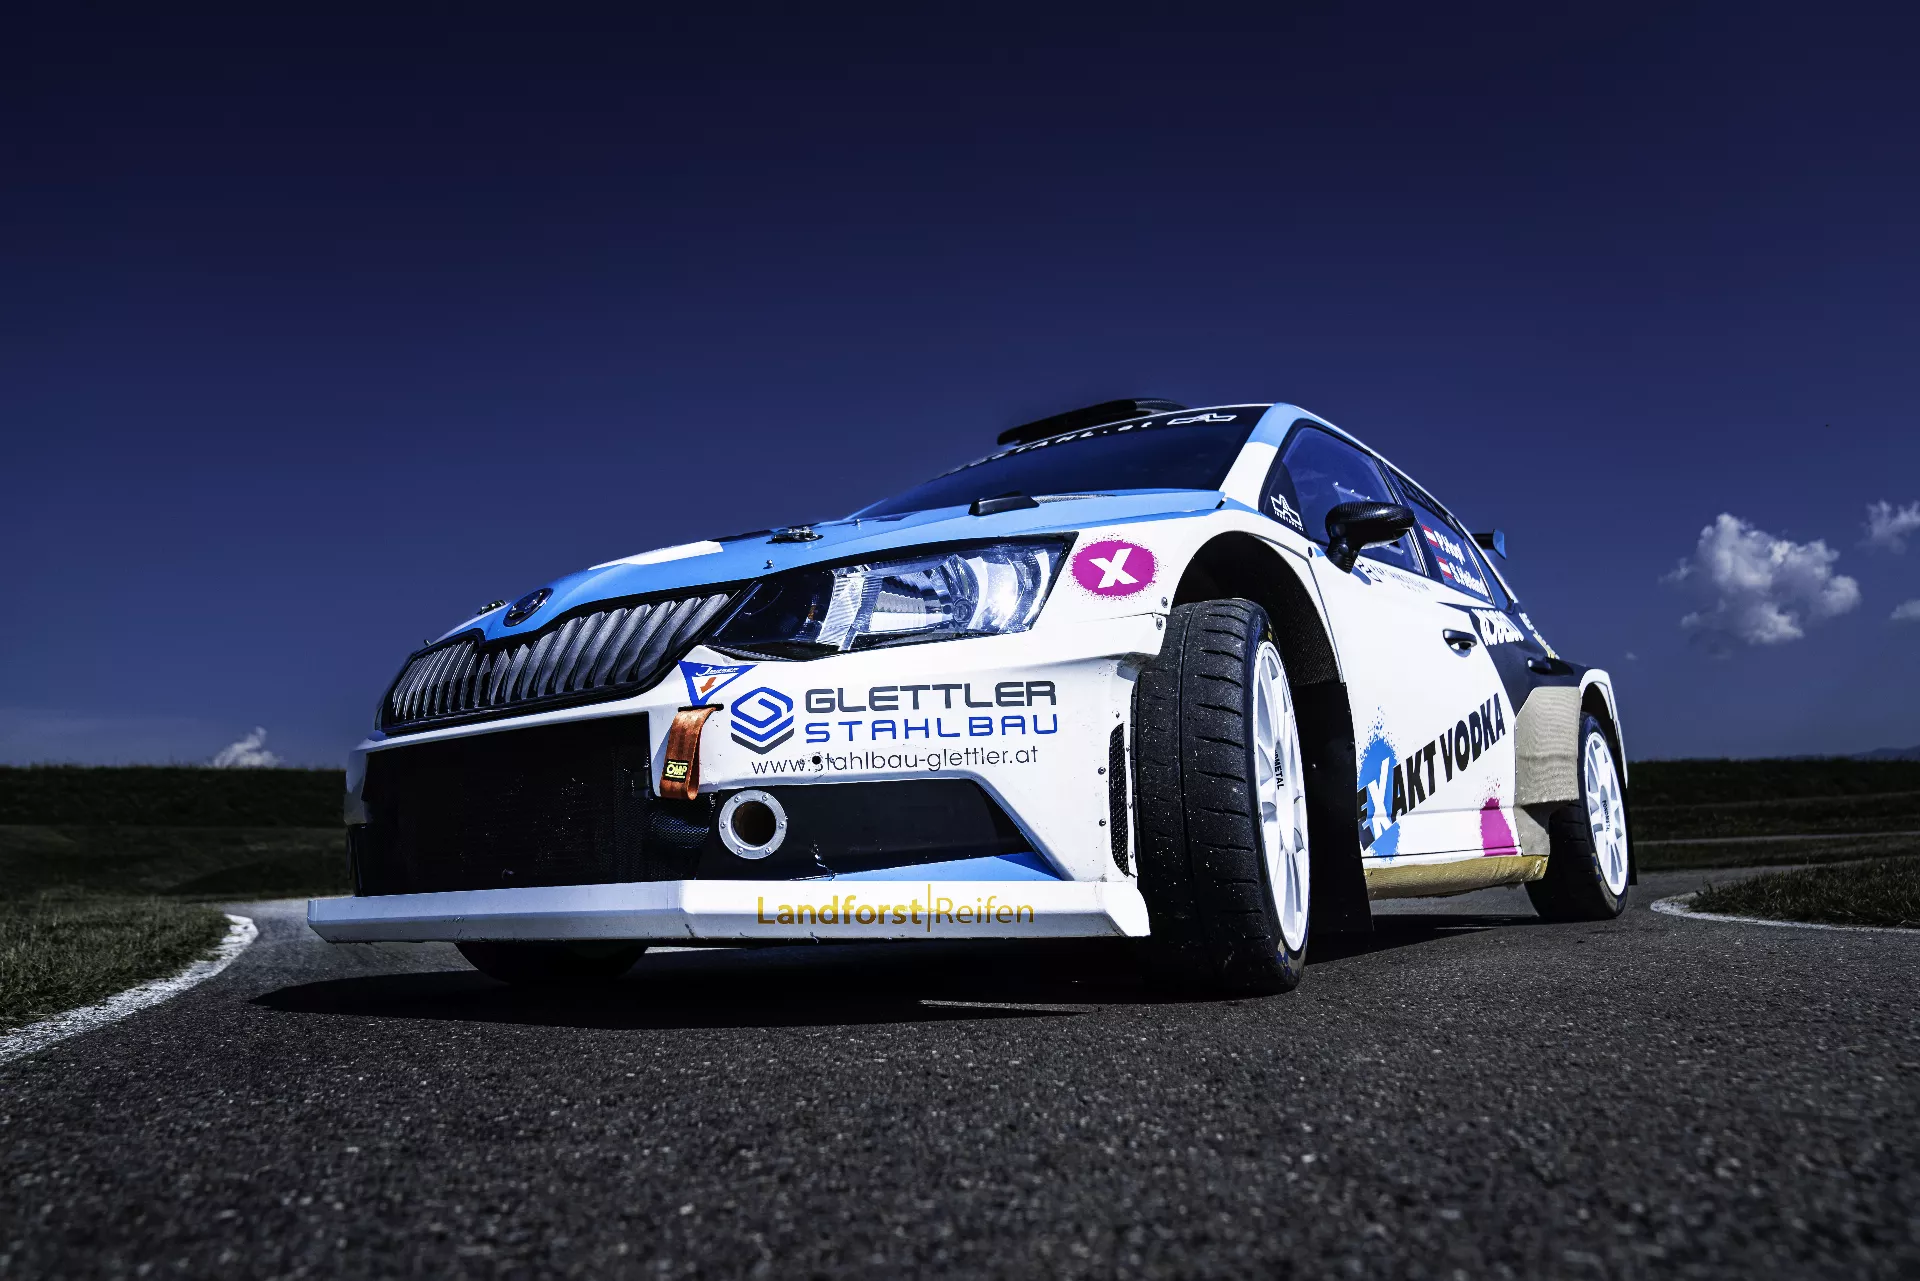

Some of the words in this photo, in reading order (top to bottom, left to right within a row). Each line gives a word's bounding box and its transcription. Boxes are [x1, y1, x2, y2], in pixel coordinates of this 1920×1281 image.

[1088, 547, 1140, 589] X
[805, 680, 1057, 714] GLETTLER
[804, 713, 1058, 744] STAHLBAU
[666, 764, 688, 776] OMP
[750, 745, 1038, 775] www.stahlbau-glettler.at
[1356, 740, 1437, 851] EXAKT
[1439, 692, 1507, 783] VODKA
[757, 894, 923, 925] Landforst
[935, 895, 1034, 925] Reifen
